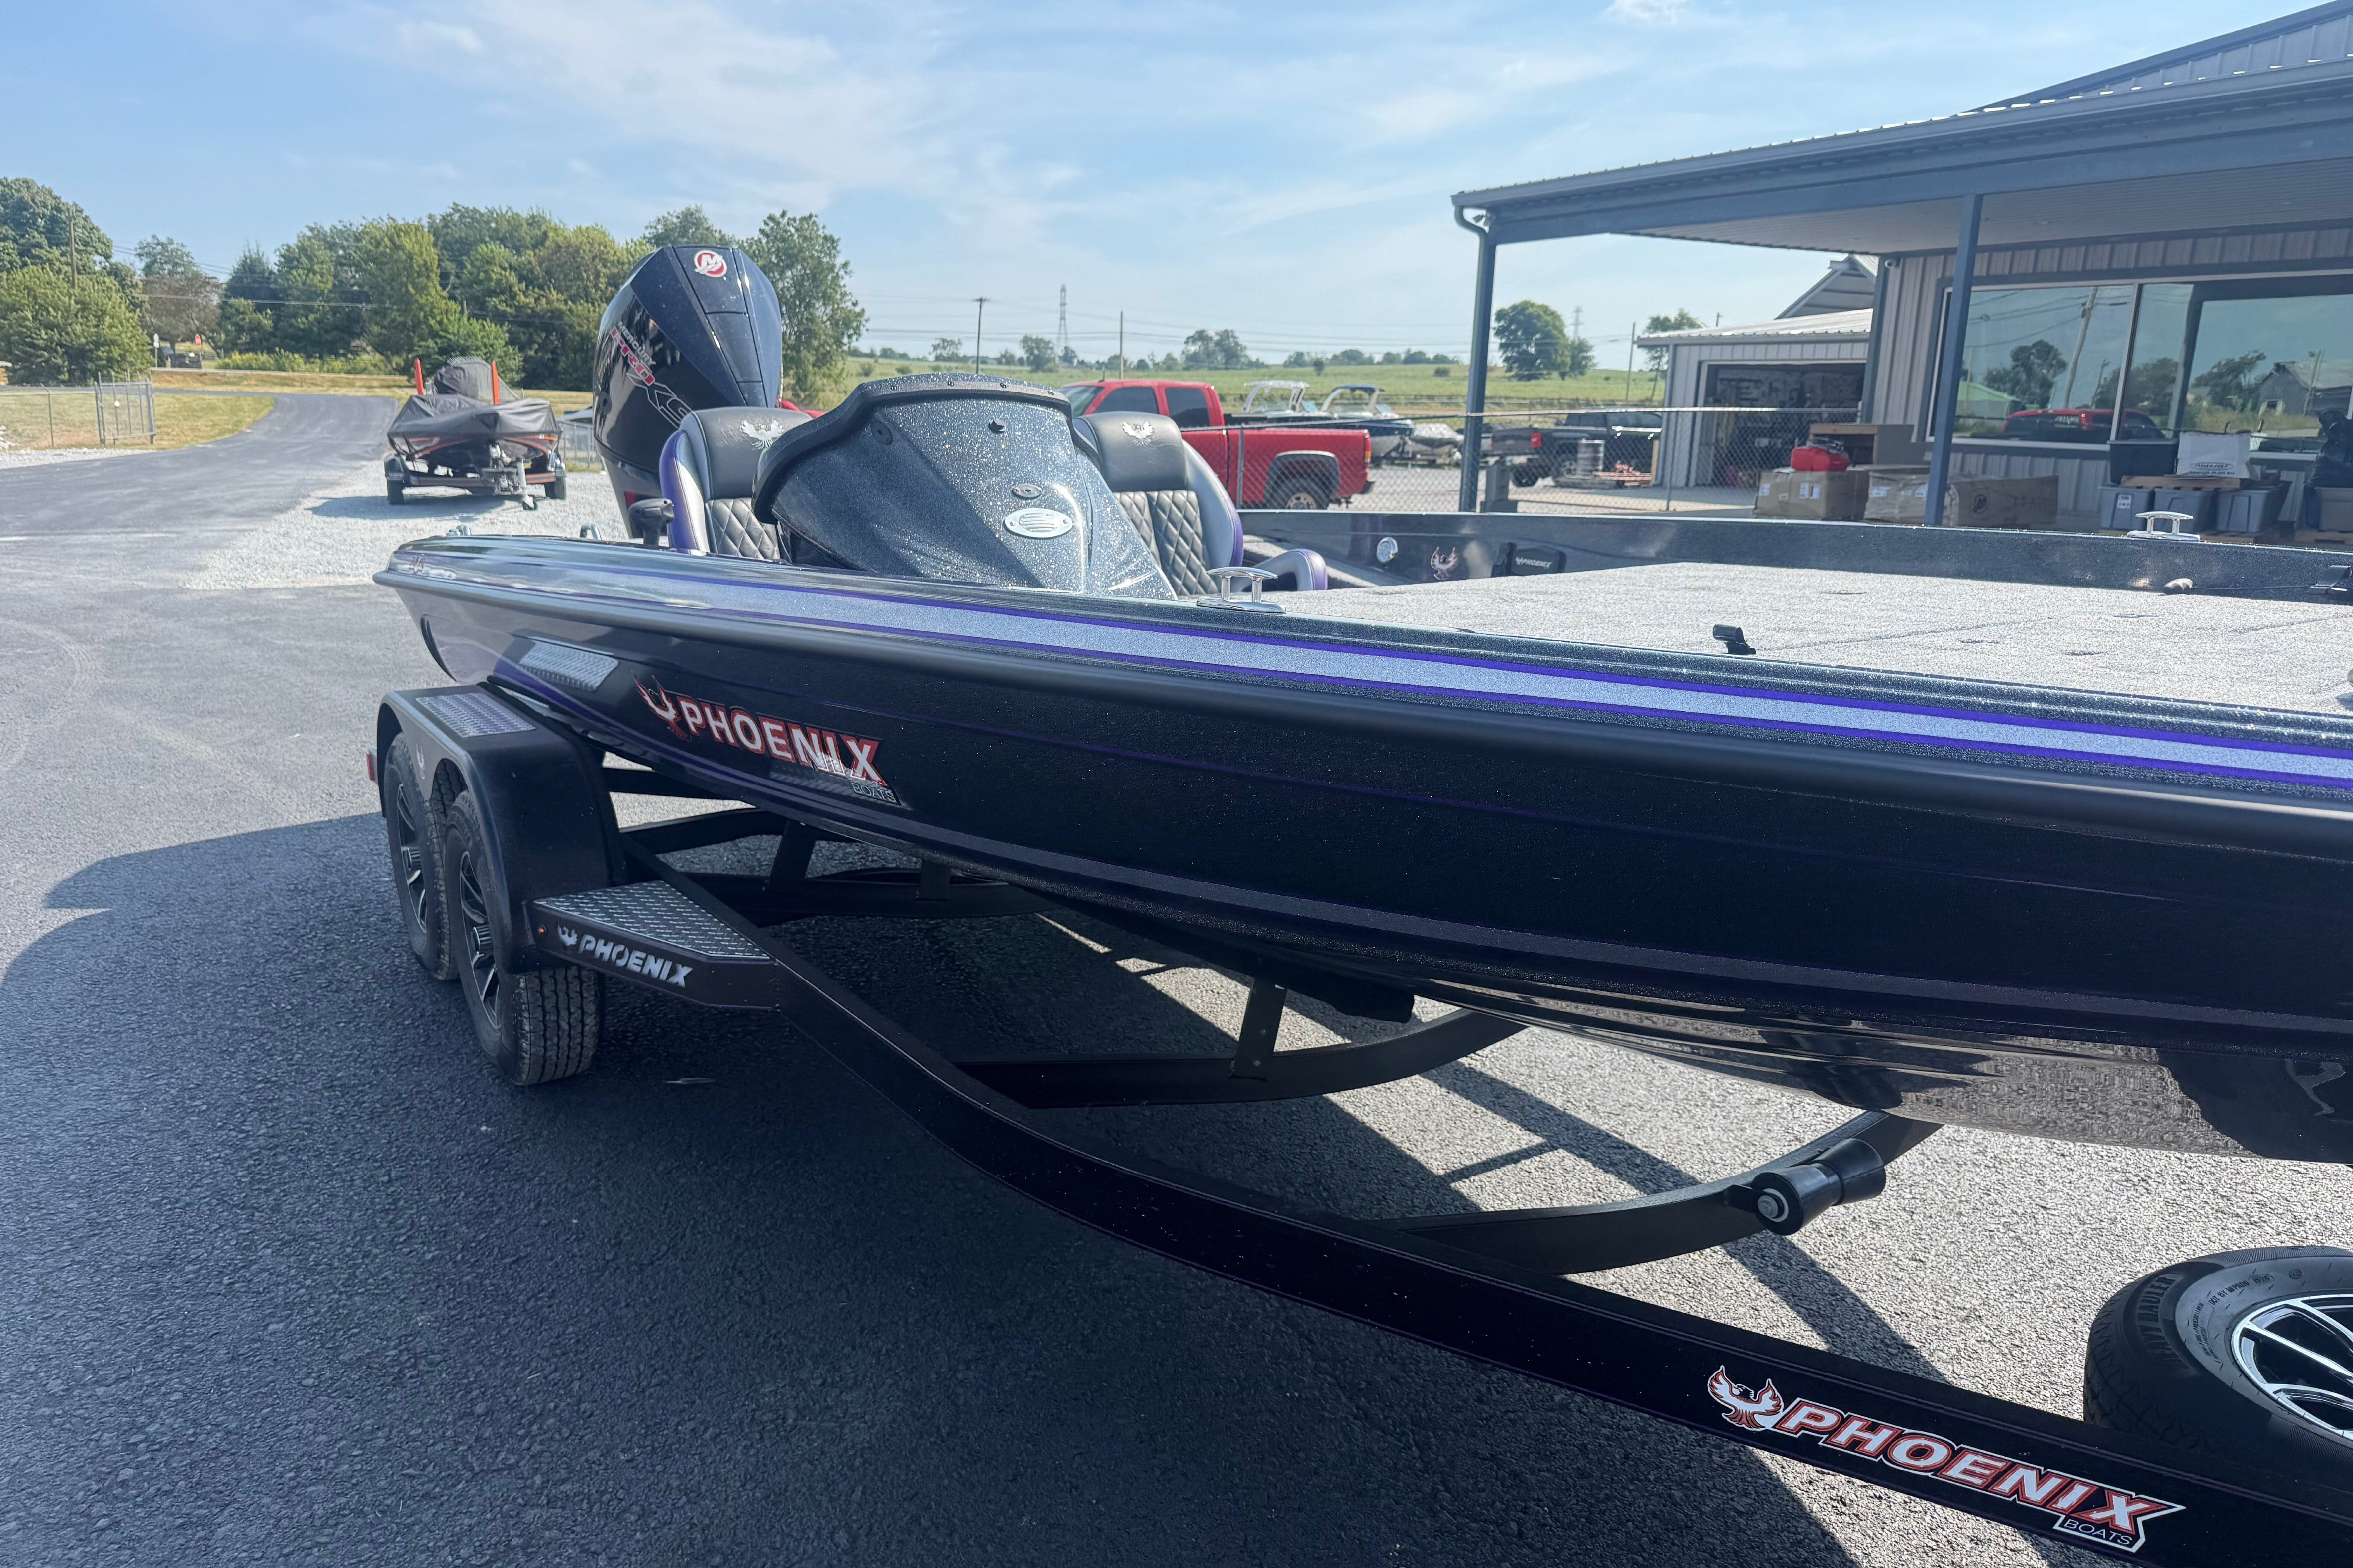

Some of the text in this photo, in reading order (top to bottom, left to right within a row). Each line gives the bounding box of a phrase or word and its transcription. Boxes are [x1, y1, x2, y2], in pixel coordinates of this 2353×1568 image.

[611, 327, 655, 386] PRO
[618, 321, 657, 365] MERCURY
[677, 696, 889, 787] PHOENIX
[851, 782, 896, 803] BOATS
[578, 934, 693, 988] PHOENIX
[2138, 1277, 2177, 1322] HAULER
[2208, 1295, 2220, 1305] DOT
[1776, 1400, 2169, 1535] PHOENIX
[2064, 1519, 2132, 1545] BOATS
